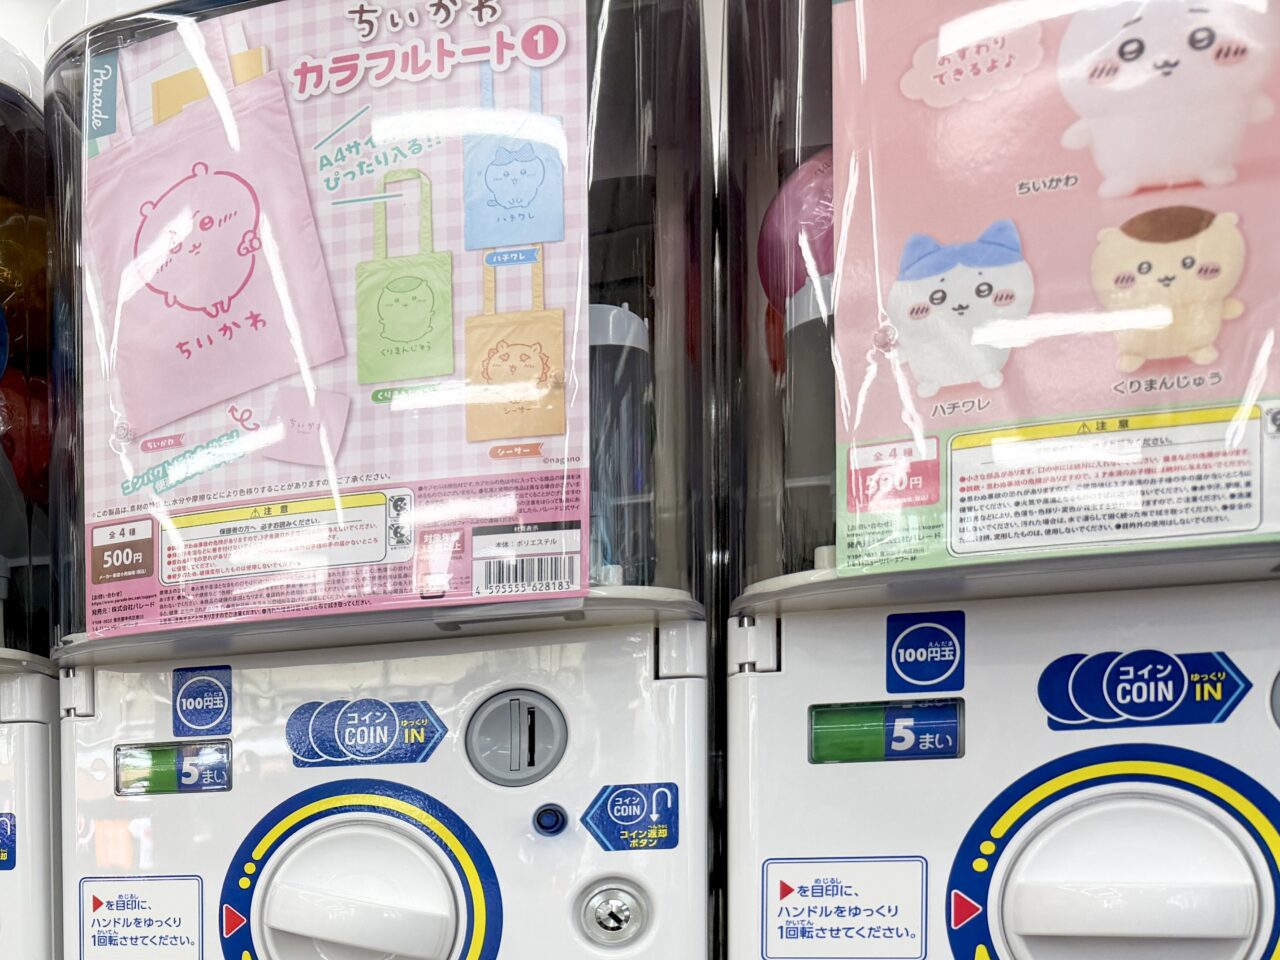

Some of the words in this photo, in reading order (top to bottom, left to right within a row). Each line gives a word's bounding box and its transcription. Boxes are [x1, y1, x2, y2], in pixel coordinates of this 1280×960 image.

[349, 0, 501, 37] ちいかわ
[93, 64, 112, 131] Parade
[1018, 174, 1078, 195] ちいかわ
[496, 213, 535, 224] ハチワレ
[493, 253, 525, 262] ハチワレ
[176, 310, 267, 360] ちいかわ
[380, 341, 432, 357] くりまんじゅう
[1113, 373, 1224, 395] くりまんじゅう
[931, 398, 991, 417] ハチワレ
[1095, 419, 1129, 430] 注意
[147, 438, 174, 449] ちいかわ
[496, 446, 531, 455] シーサー
[873, 448, 913, 461] 全4種
[264, 505, 289, 516] 注意
[108, 527, 136, 540] 全4種
[495, 538, 558, 548] 本体：ポリエステル
[103, 547, 143, 568] 500円
[898, 645, 955, 663] 100円玉
[1119, 665, 1172, 680] コイン
[1115, 680, 1174, 704] COIN
[1195, 682, 1223, 701] IN
[181, 695, 224, 711] 100円玉
[347, 711, 387, 725] コイン
[345, 725, 388, 745] COIN
[403, 727, 425, 744] IN
[890, 717, 915, 750] 5
[919, 732, 953, 750] まい
[180, 757, 200, 784] 5
[202, 768, 227, 784] まい
[614, 805, 641, 816] COIN
[797, 883, 860, 899] を目印に、
[105, 898, 154, 912] を目印に、
[778, 904, 899, 918] ハンドルをゆっくり
[92, 916, 183, 928] ハンドルをゆっくり
[778, 923, 917, 940] 1回転させてください。
[91, 933, 197, 949] 1回転させてください。
